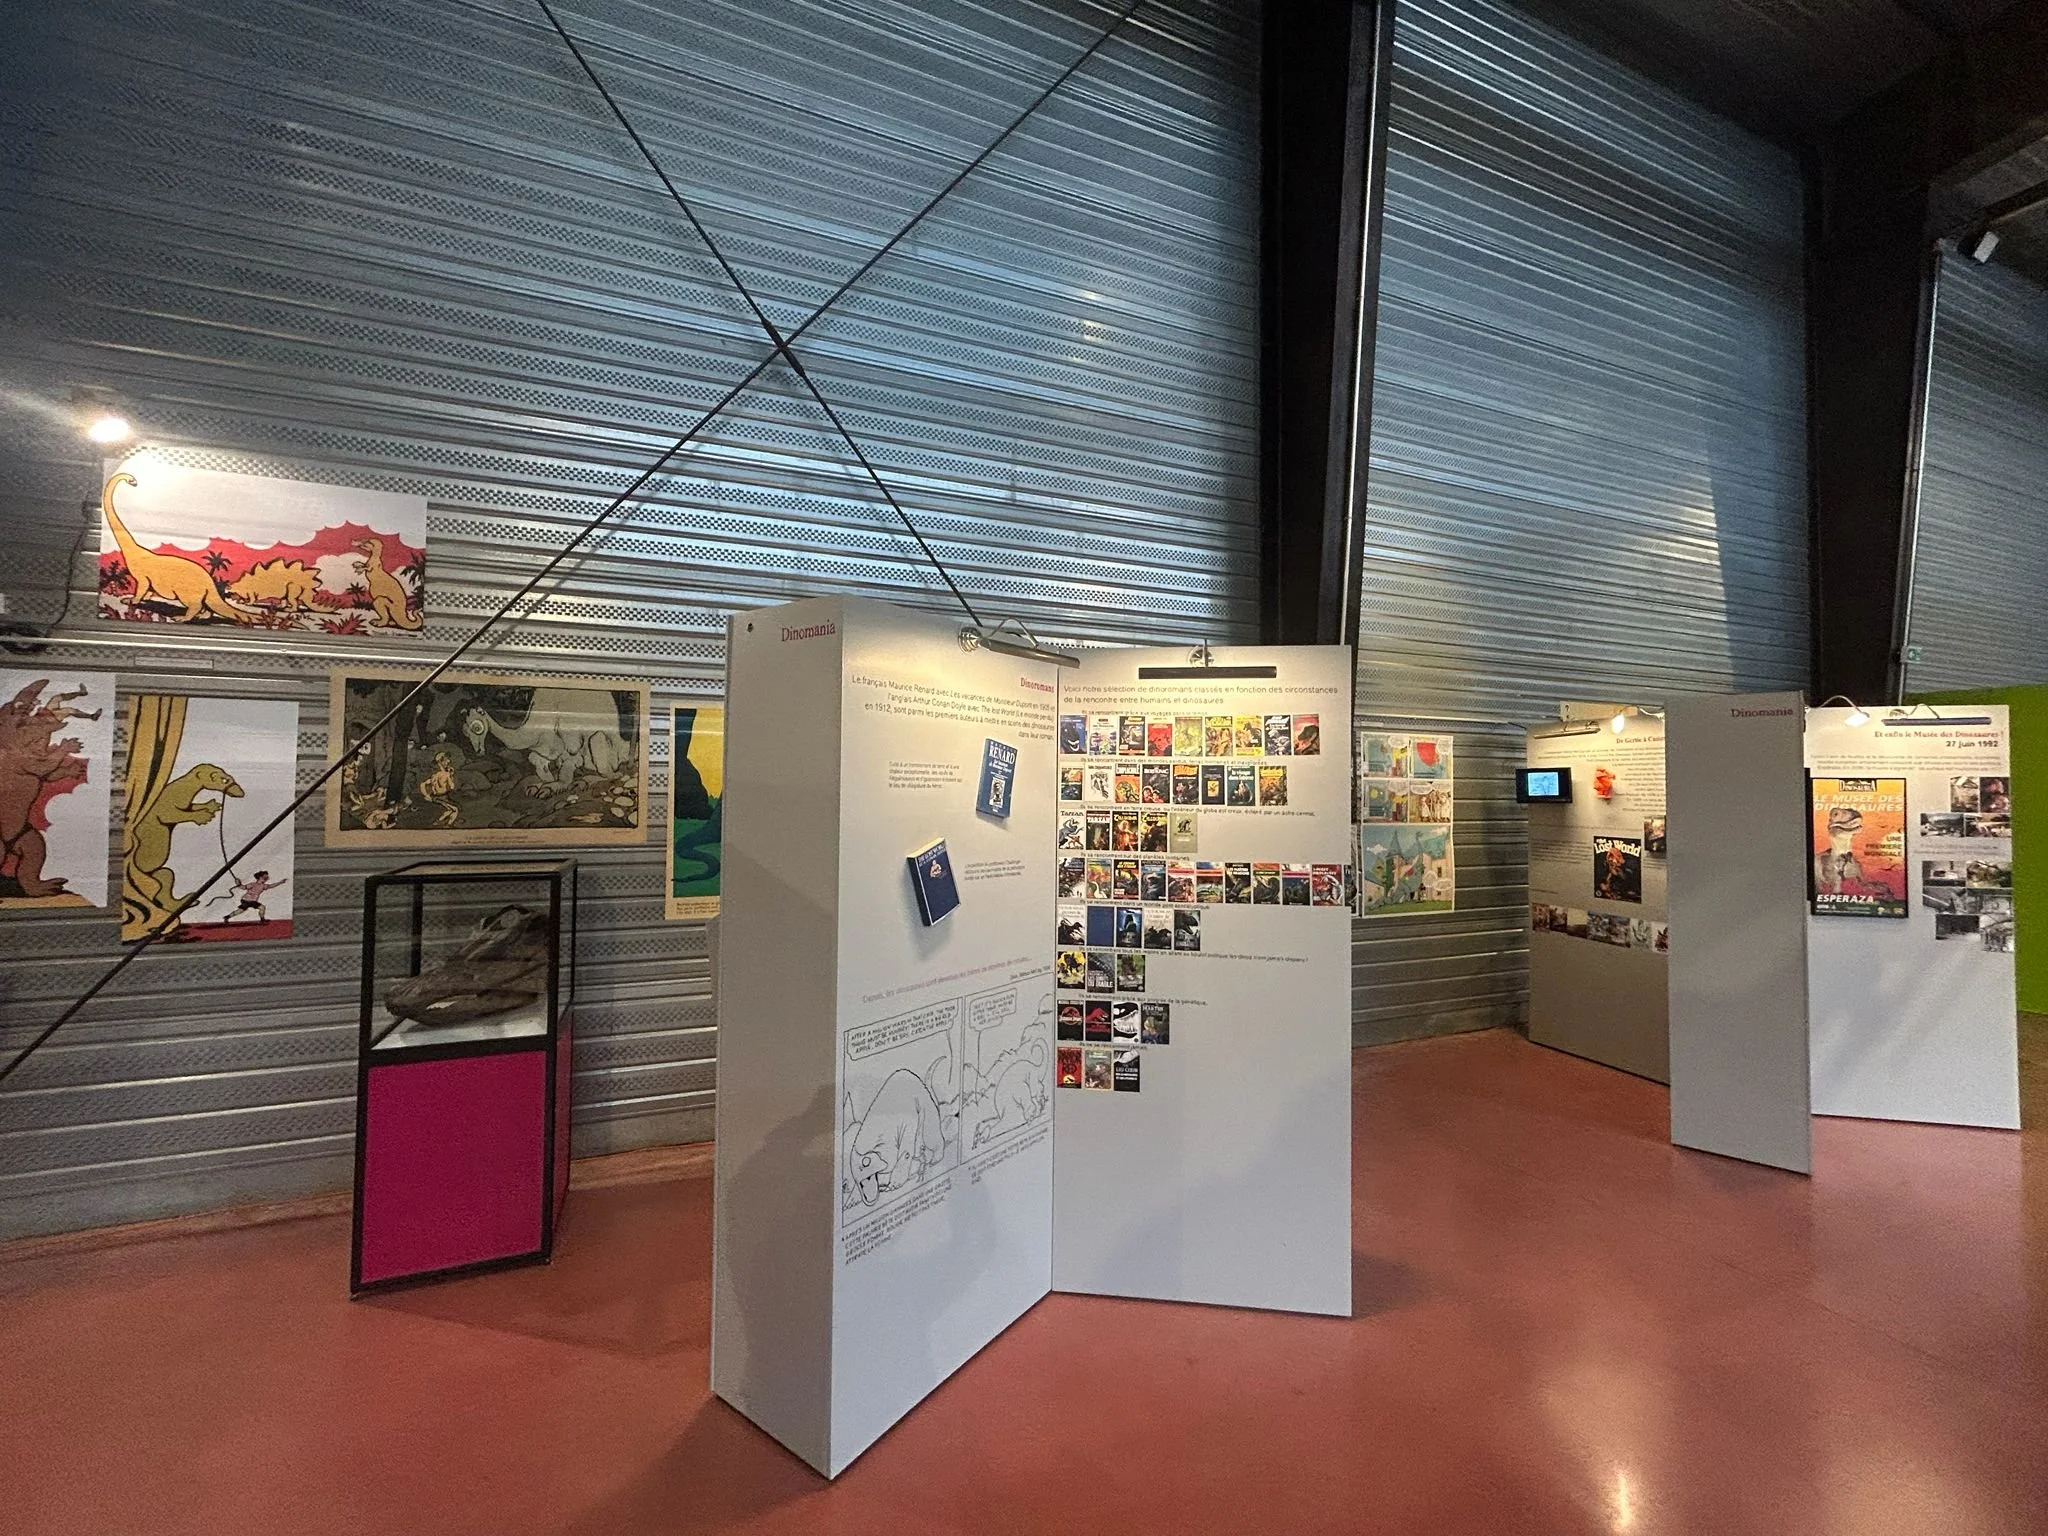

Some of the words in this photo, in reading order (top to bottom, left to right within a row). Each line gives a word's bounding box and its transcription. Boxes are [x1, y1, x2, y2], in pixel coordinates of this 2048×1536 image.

[781, 619, 836, 642] Dinomania
[852, 675, 861, 684] Le
[862, 676, 887, 689] français
[888, 680, 913, 692] Maurice
[914, 684, 935, 695] Renard
[936, 689, 949, 697] avec
[950, 690, 960, 699] Les
[1020, 677, 1055, 693] Dinoromans
[1063, 685, 1081, 693] Voici
[1082, 685, 1101, 693] notre
[1103, 685, 1136, 693] sélection
[1138, 685, 1147, 693] de
[1148, 685, 1192, 693] dinoromans
[1225, 686, 1234, 694] en
[1236, 685, 1267, 694] fonction
[1269, 686, 1282, 694] des
[1285, 686, 1339, 695] circonstances
[913, 696, 931, 706] Arthur
[931, 698, 950, 708] Conan
[1063, 696, 1073, 704] de
[1074, 696, 1081, 704] la
[1183, 697, 1224, 705] dinosaures
[864, 703, 873, 711] en
[875, 703, 892, 714] 1912,
[893, 706, 907, 714] sont
[907, 708, 924, 716] parmi
[926, 709, 934, 717] les
[1731, 708, 1794, 718] Dinomania
[1885, 730, 1904, 738] enfin
[1905, 730, 1913, 738] le
[1914, 730, 1938, 738] Musée
[1939, 730, 1953, 738] des
[1955, 730, 1999, 739] Dinosaures
[1945, 740, 1956, 748] 27
[1958, 740, 1976, 749] juin
[1977, 740, 1999, 748] 1992
[988, 745, 1016, 765] RENARD
[1814, 794, 1829, 803] LE
[1879, 794, 1903, 803] DES
[1814, 802, 1903, 812] DINOSAURES
[1594, 840, 1615, 855] Lost
[1614, 839, 1641, 857] World
[1816, 894, 1875, 904] ESPERAZA
